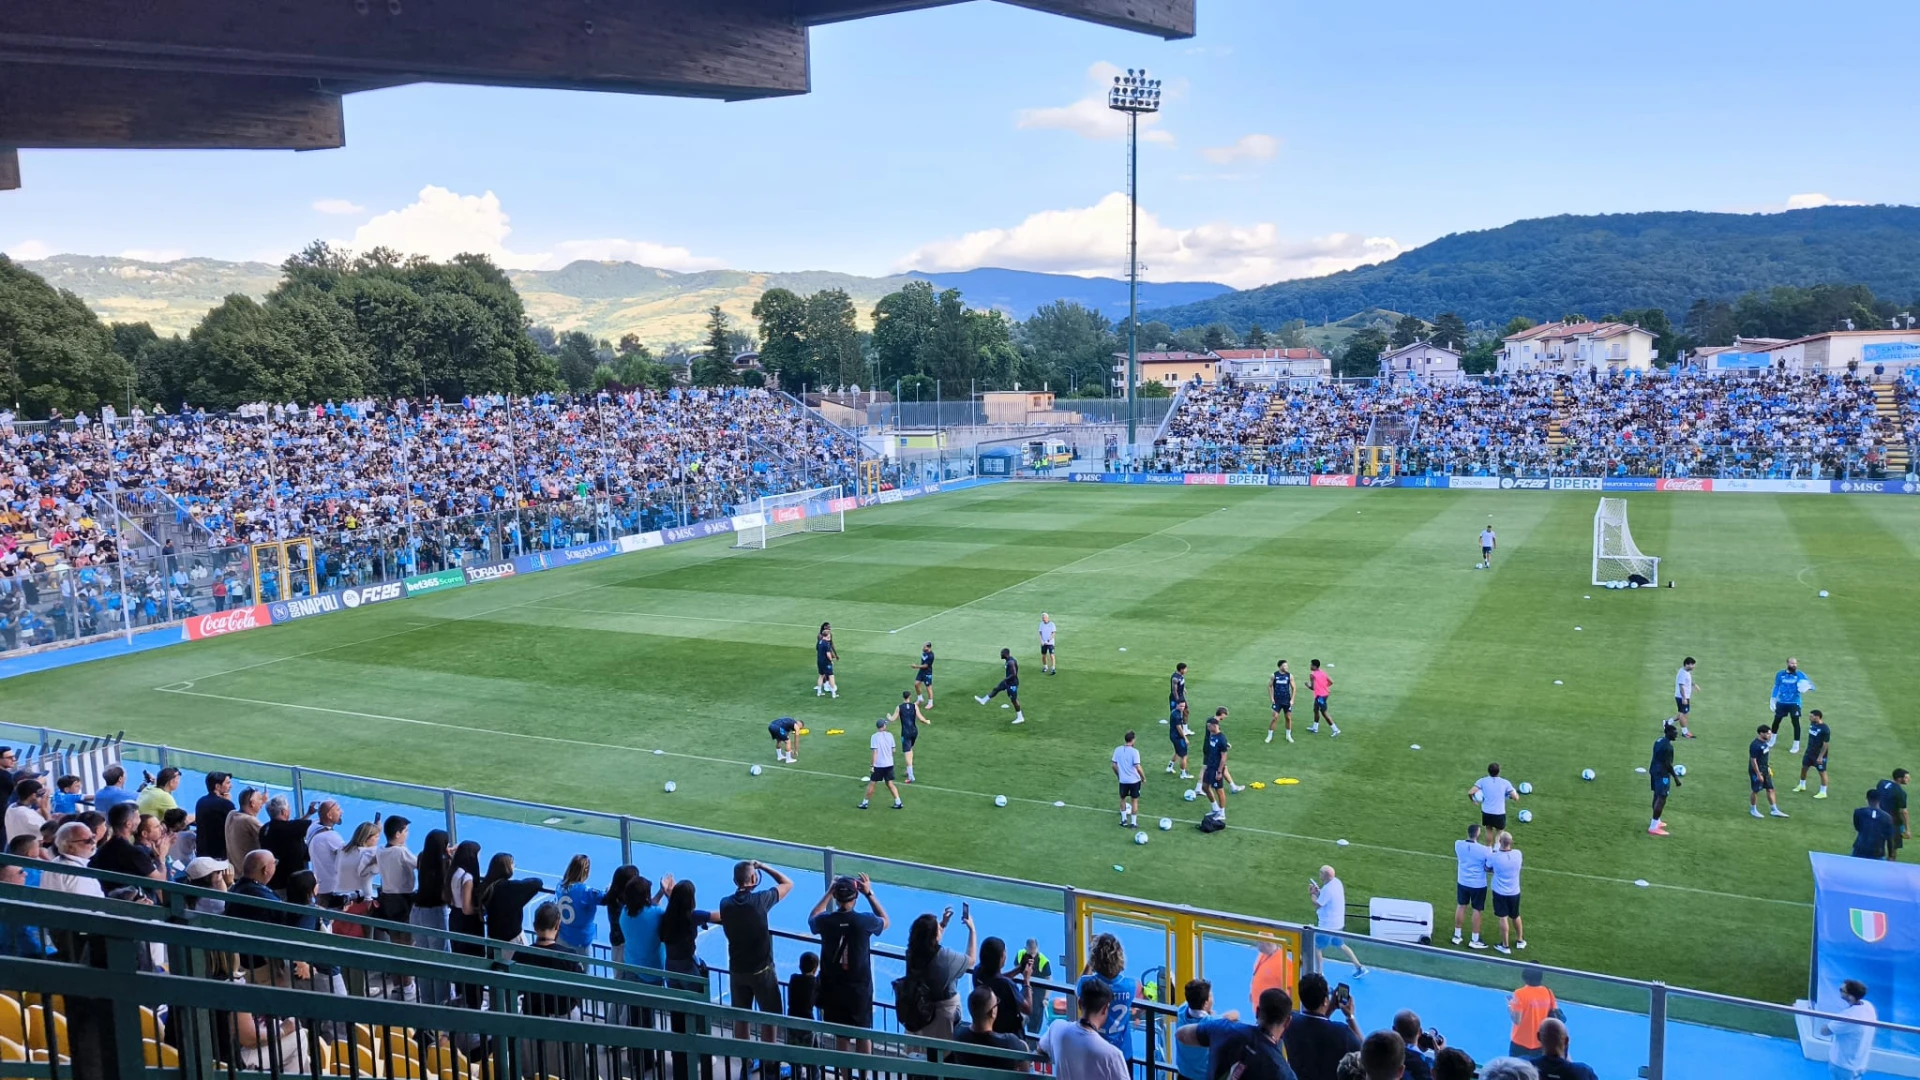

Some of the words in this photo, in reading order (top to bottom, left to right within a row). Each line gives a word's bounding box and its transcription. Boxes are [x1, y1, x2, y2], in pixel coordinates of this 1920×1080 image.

[1082, 474, 1101, 482] MSC
[1191, 475, 1217, 484] enel
[1285, 476, 1310, 485] NAPOLI
[1316, 475, 1349, 486] Coca-Cola
[1513, 479, 1549, 488] FC26
[1663, 479, 1704, 491] Coca-Cola
[1853, 483, 1883, 492] MSC
[712, 521, 730, 532] MSC
[675, 527, 696, 539] MSC
[564, 544, 609, 560] SORGESANA
[466, 562, 514, 580] TORALDO
[406, 576, 440, 592] bet365
[439, 574, 463, 586] Scores
[360, 582, 401, 604] FC26
[298, 593, 339, 617] NAPOLI
[200, 606, 256, 637] Coca-Cola
[558, 895, 575, 925] 6
